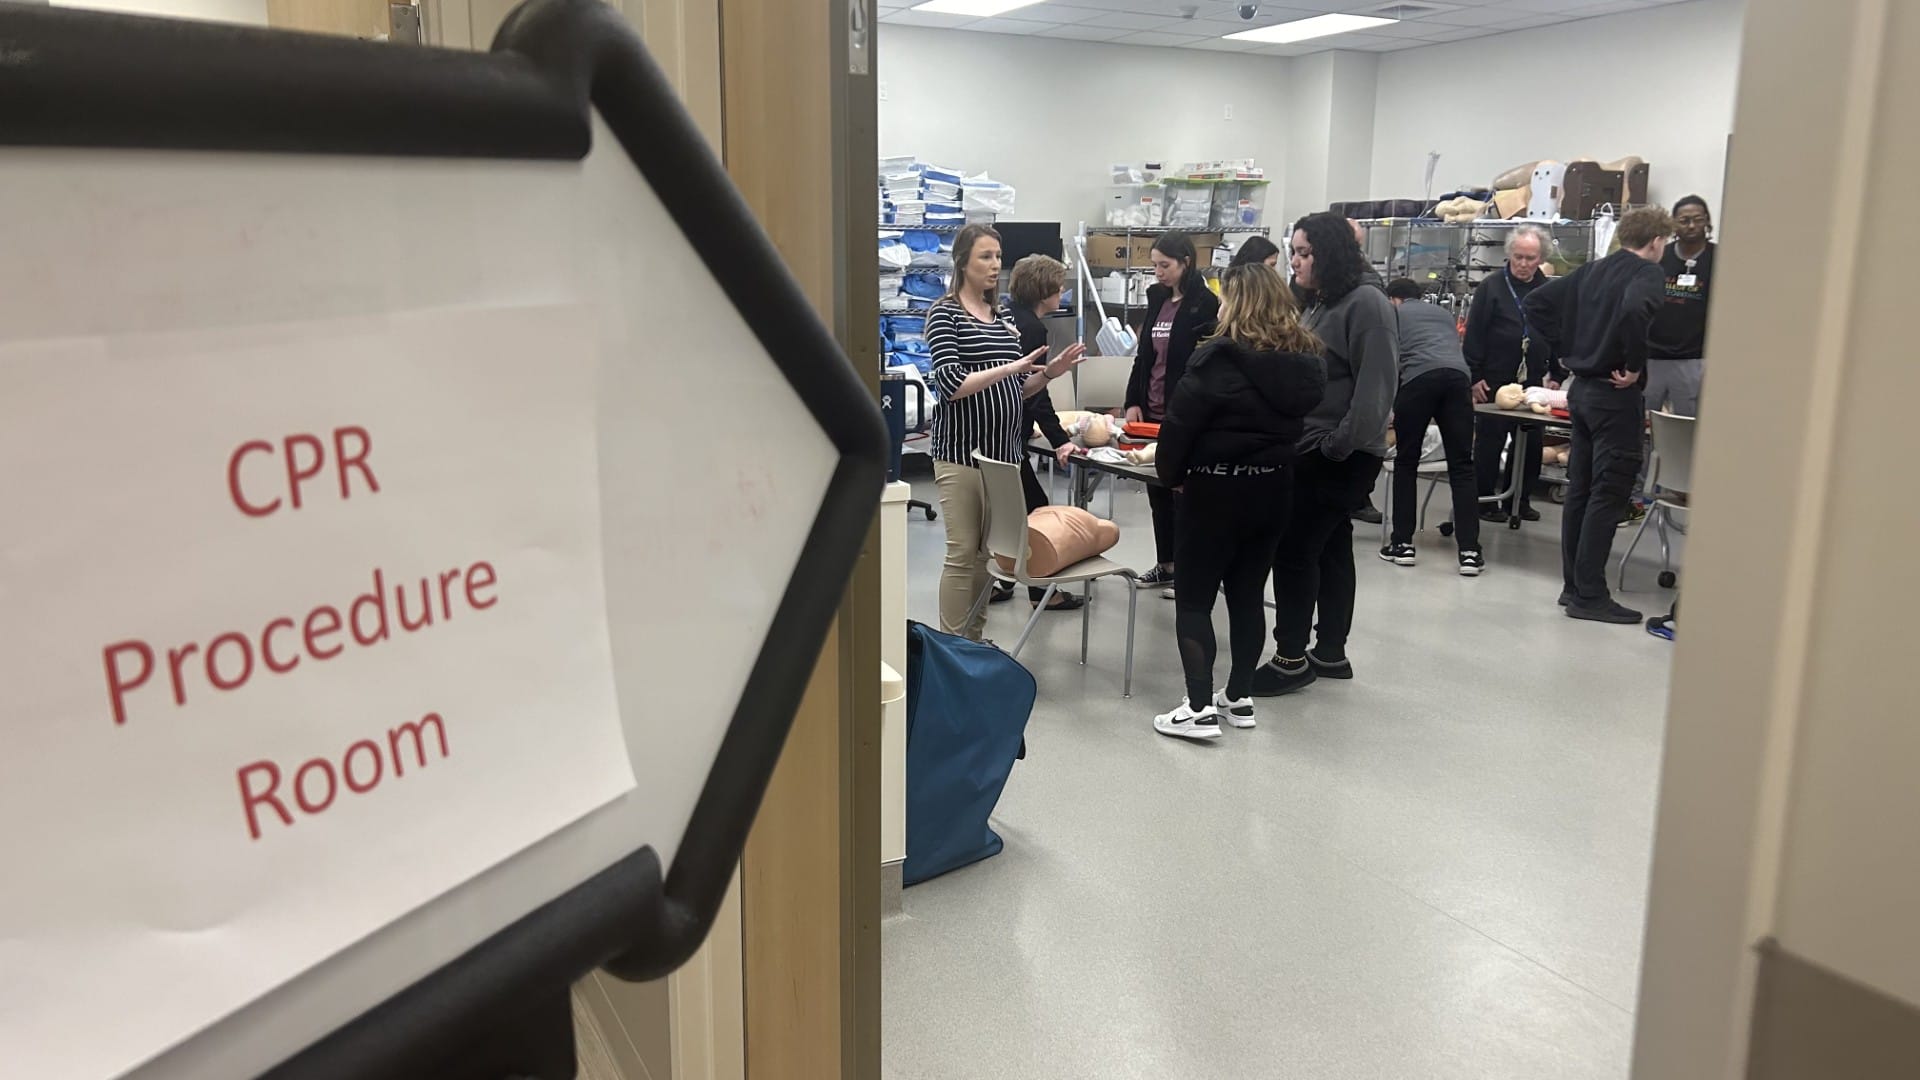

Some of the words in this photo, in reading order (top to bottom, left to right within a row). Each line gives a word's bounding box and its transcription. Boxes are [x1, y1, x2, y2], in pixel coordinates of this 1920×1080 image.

[226, 425, 380, 518] CPR
[102, 560, 498, 726] Procedure
[235, 712, 449, 841] Room
